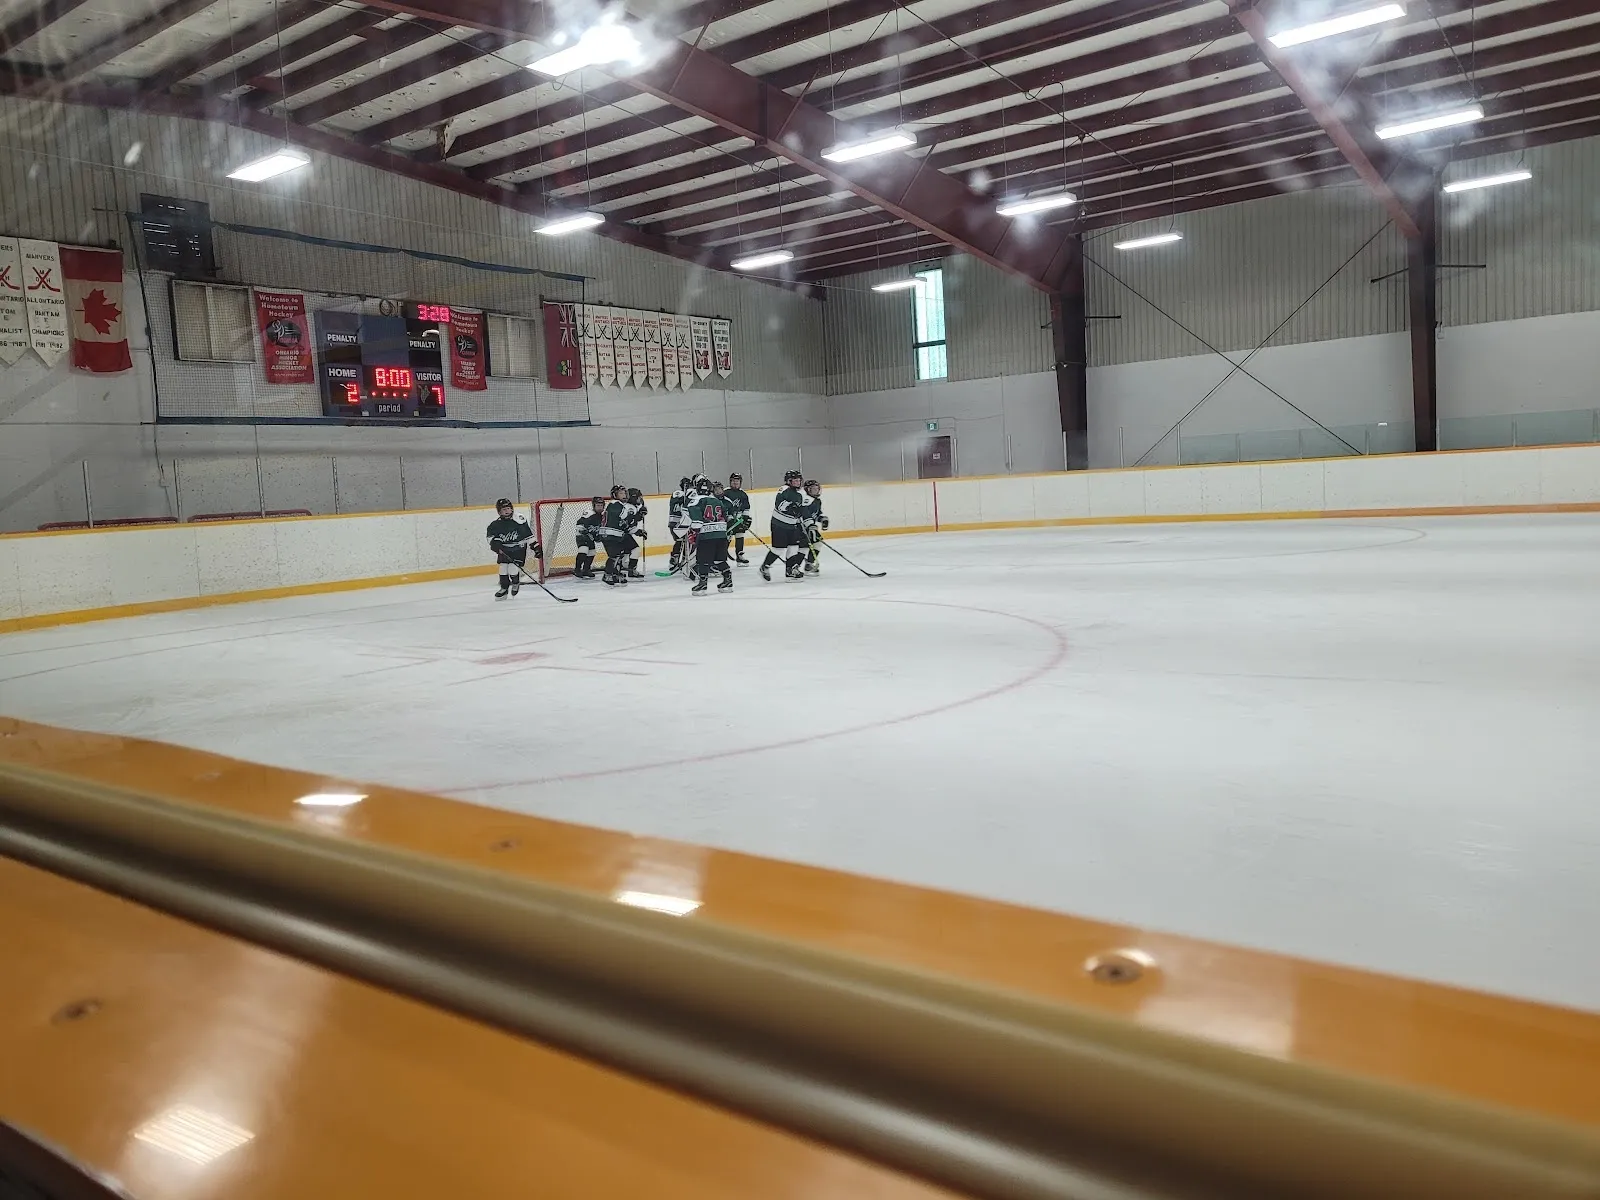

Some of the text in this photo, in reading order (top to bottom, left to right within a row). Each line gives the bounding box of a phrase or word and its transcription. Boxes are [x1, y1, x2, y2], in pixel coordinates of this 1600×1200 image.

[259, 294, 289, 303] Welcome
[261, 302, 299, 311] Hometown
[269, 311, 294, 319] Hockey
[418, 304, 449, 322] 3:28
[32, 328, 65, 336] CHAMPIONS
[327, 333, 357, 343] PENALTY
[409, 340, 436, 349] PENALTY
[328, 368, 357, 378] HOME
[375, 368, 411, 388] 8:00
[416, 372, 442, 382] VISITOR
[347, 384, 358, 402] 2
[431, 387, 442, 405] 7
[378, 404, 401, 413] period
